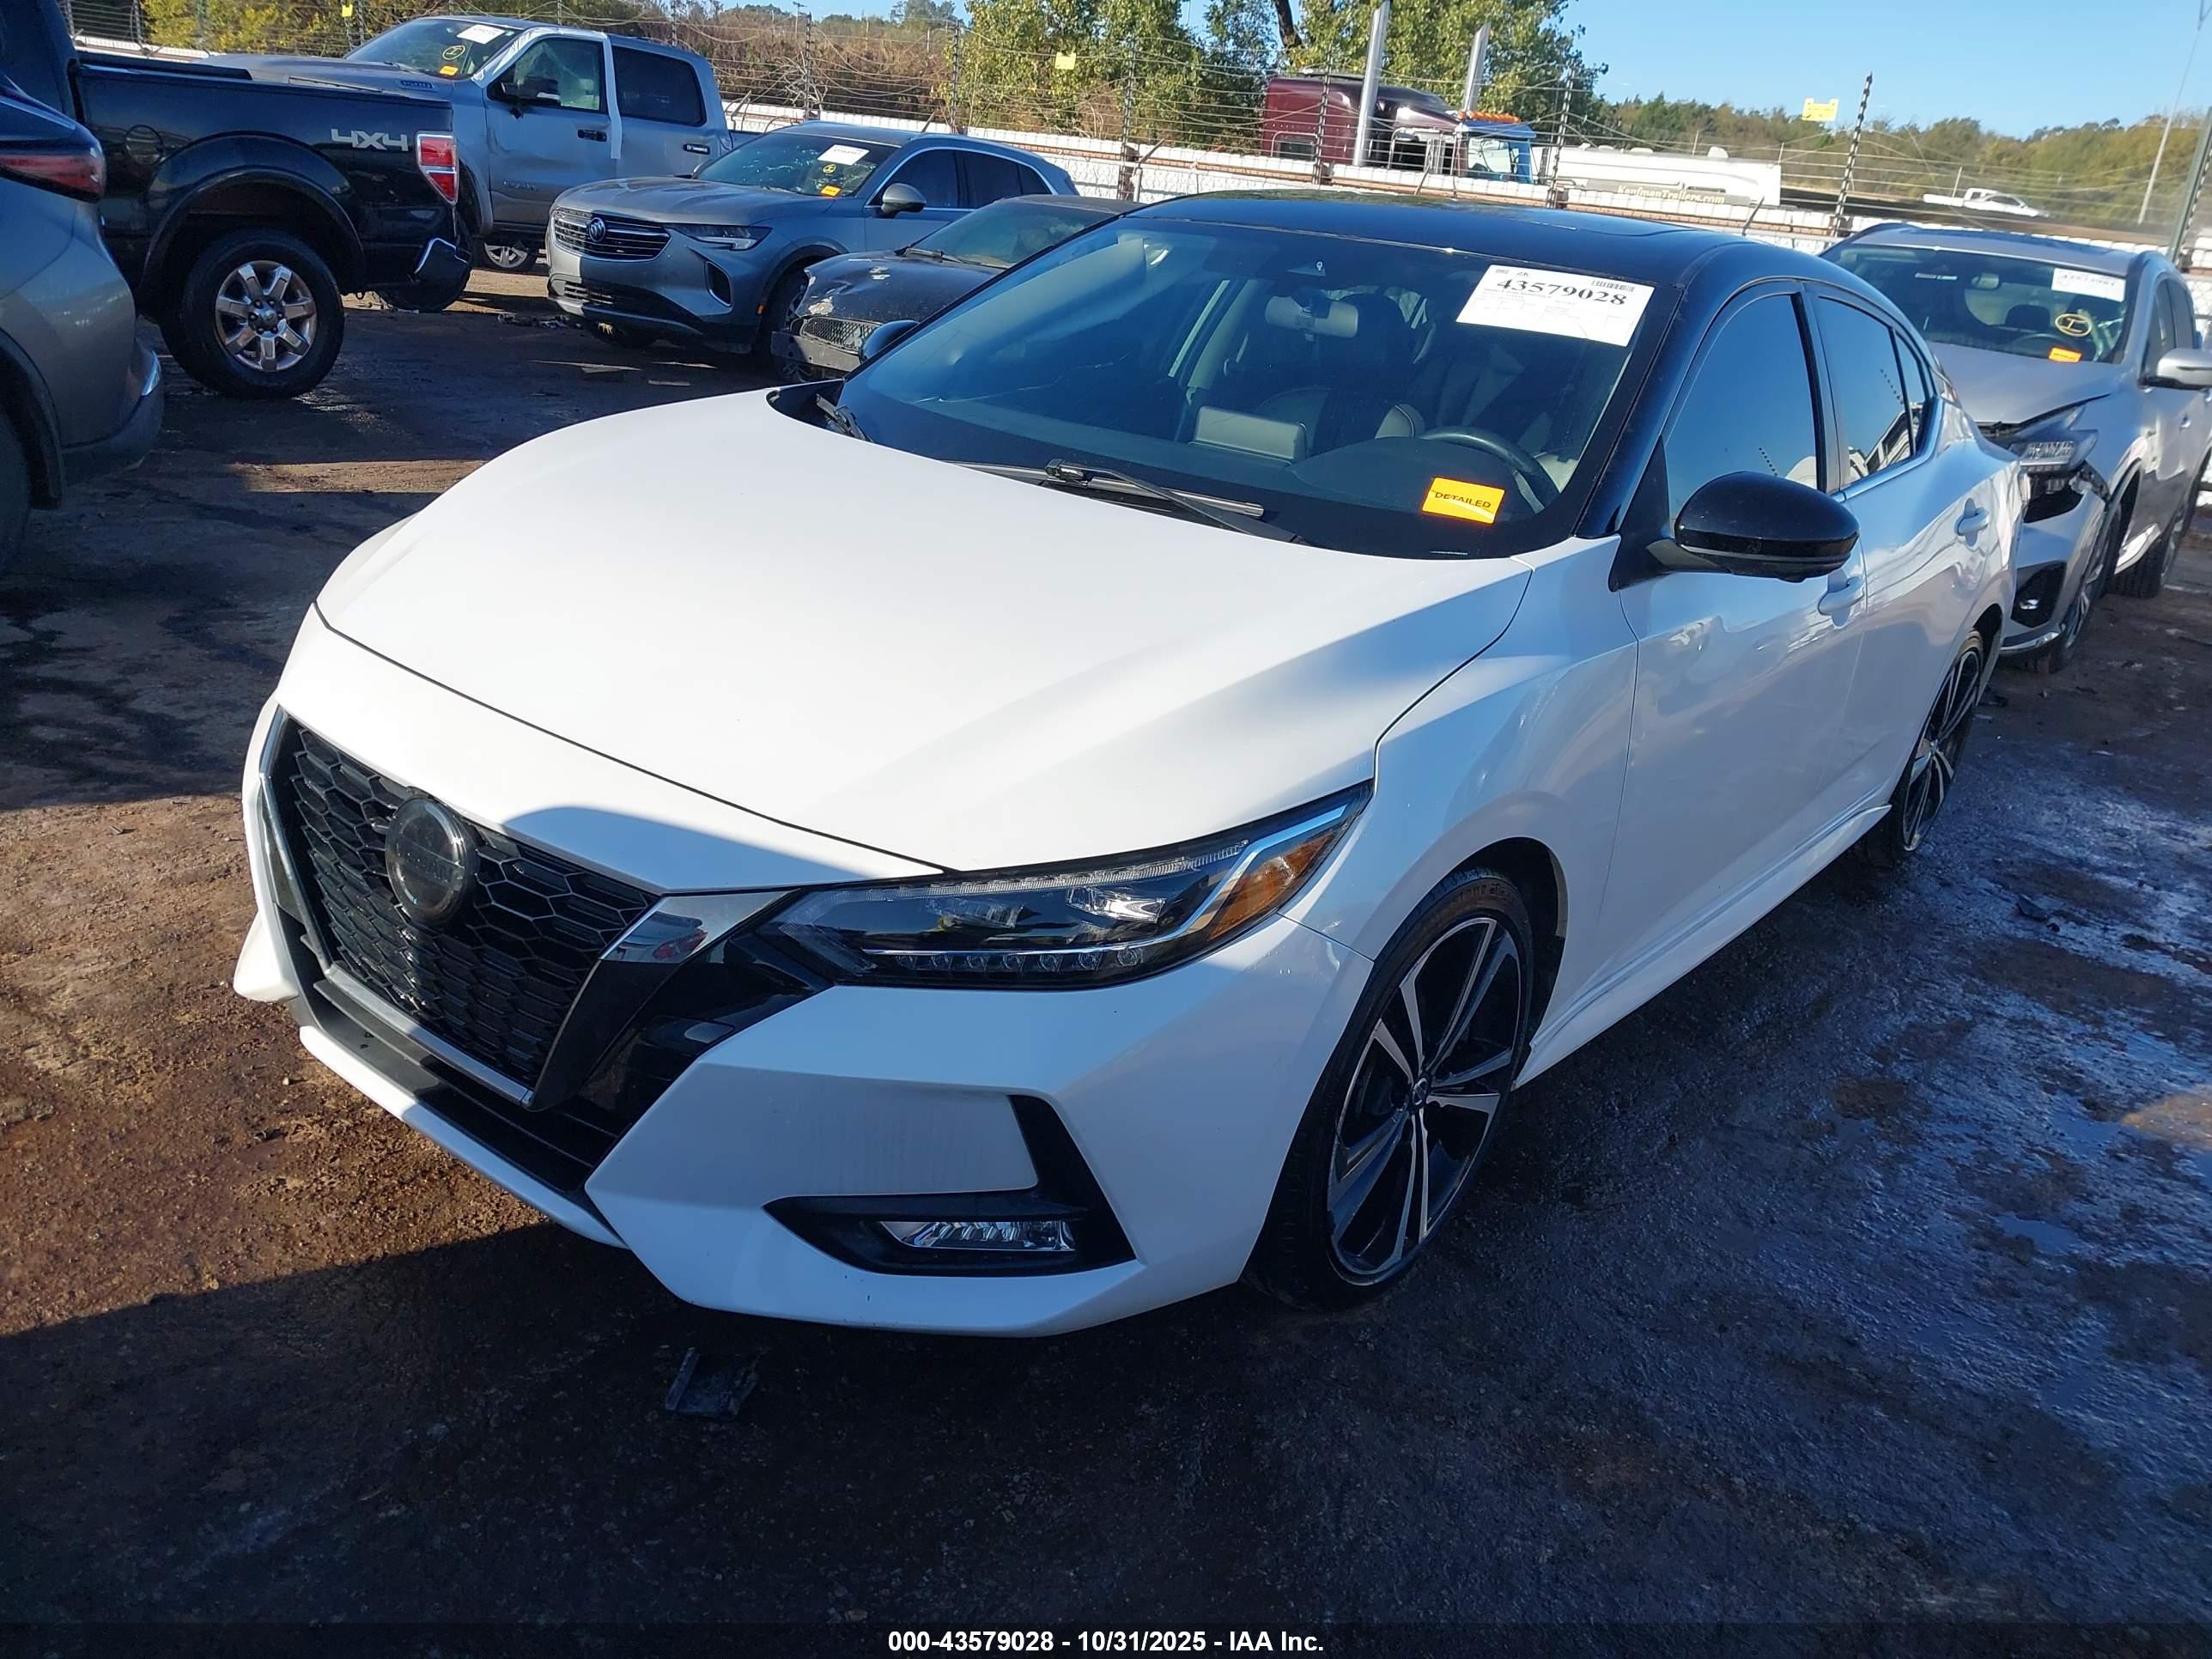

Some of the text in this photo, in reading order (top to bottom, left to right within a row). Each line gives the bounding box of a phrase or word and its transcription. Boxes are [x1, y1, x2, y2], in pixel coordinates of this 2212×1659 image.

[331, 129, 409, 152] 4X4
[1617, 185, 1725, 204] KaufmanTrailers.com
[1497, 278, 1627, 306] 43579028
[1435, 492, 1492, 508] DETAILED
